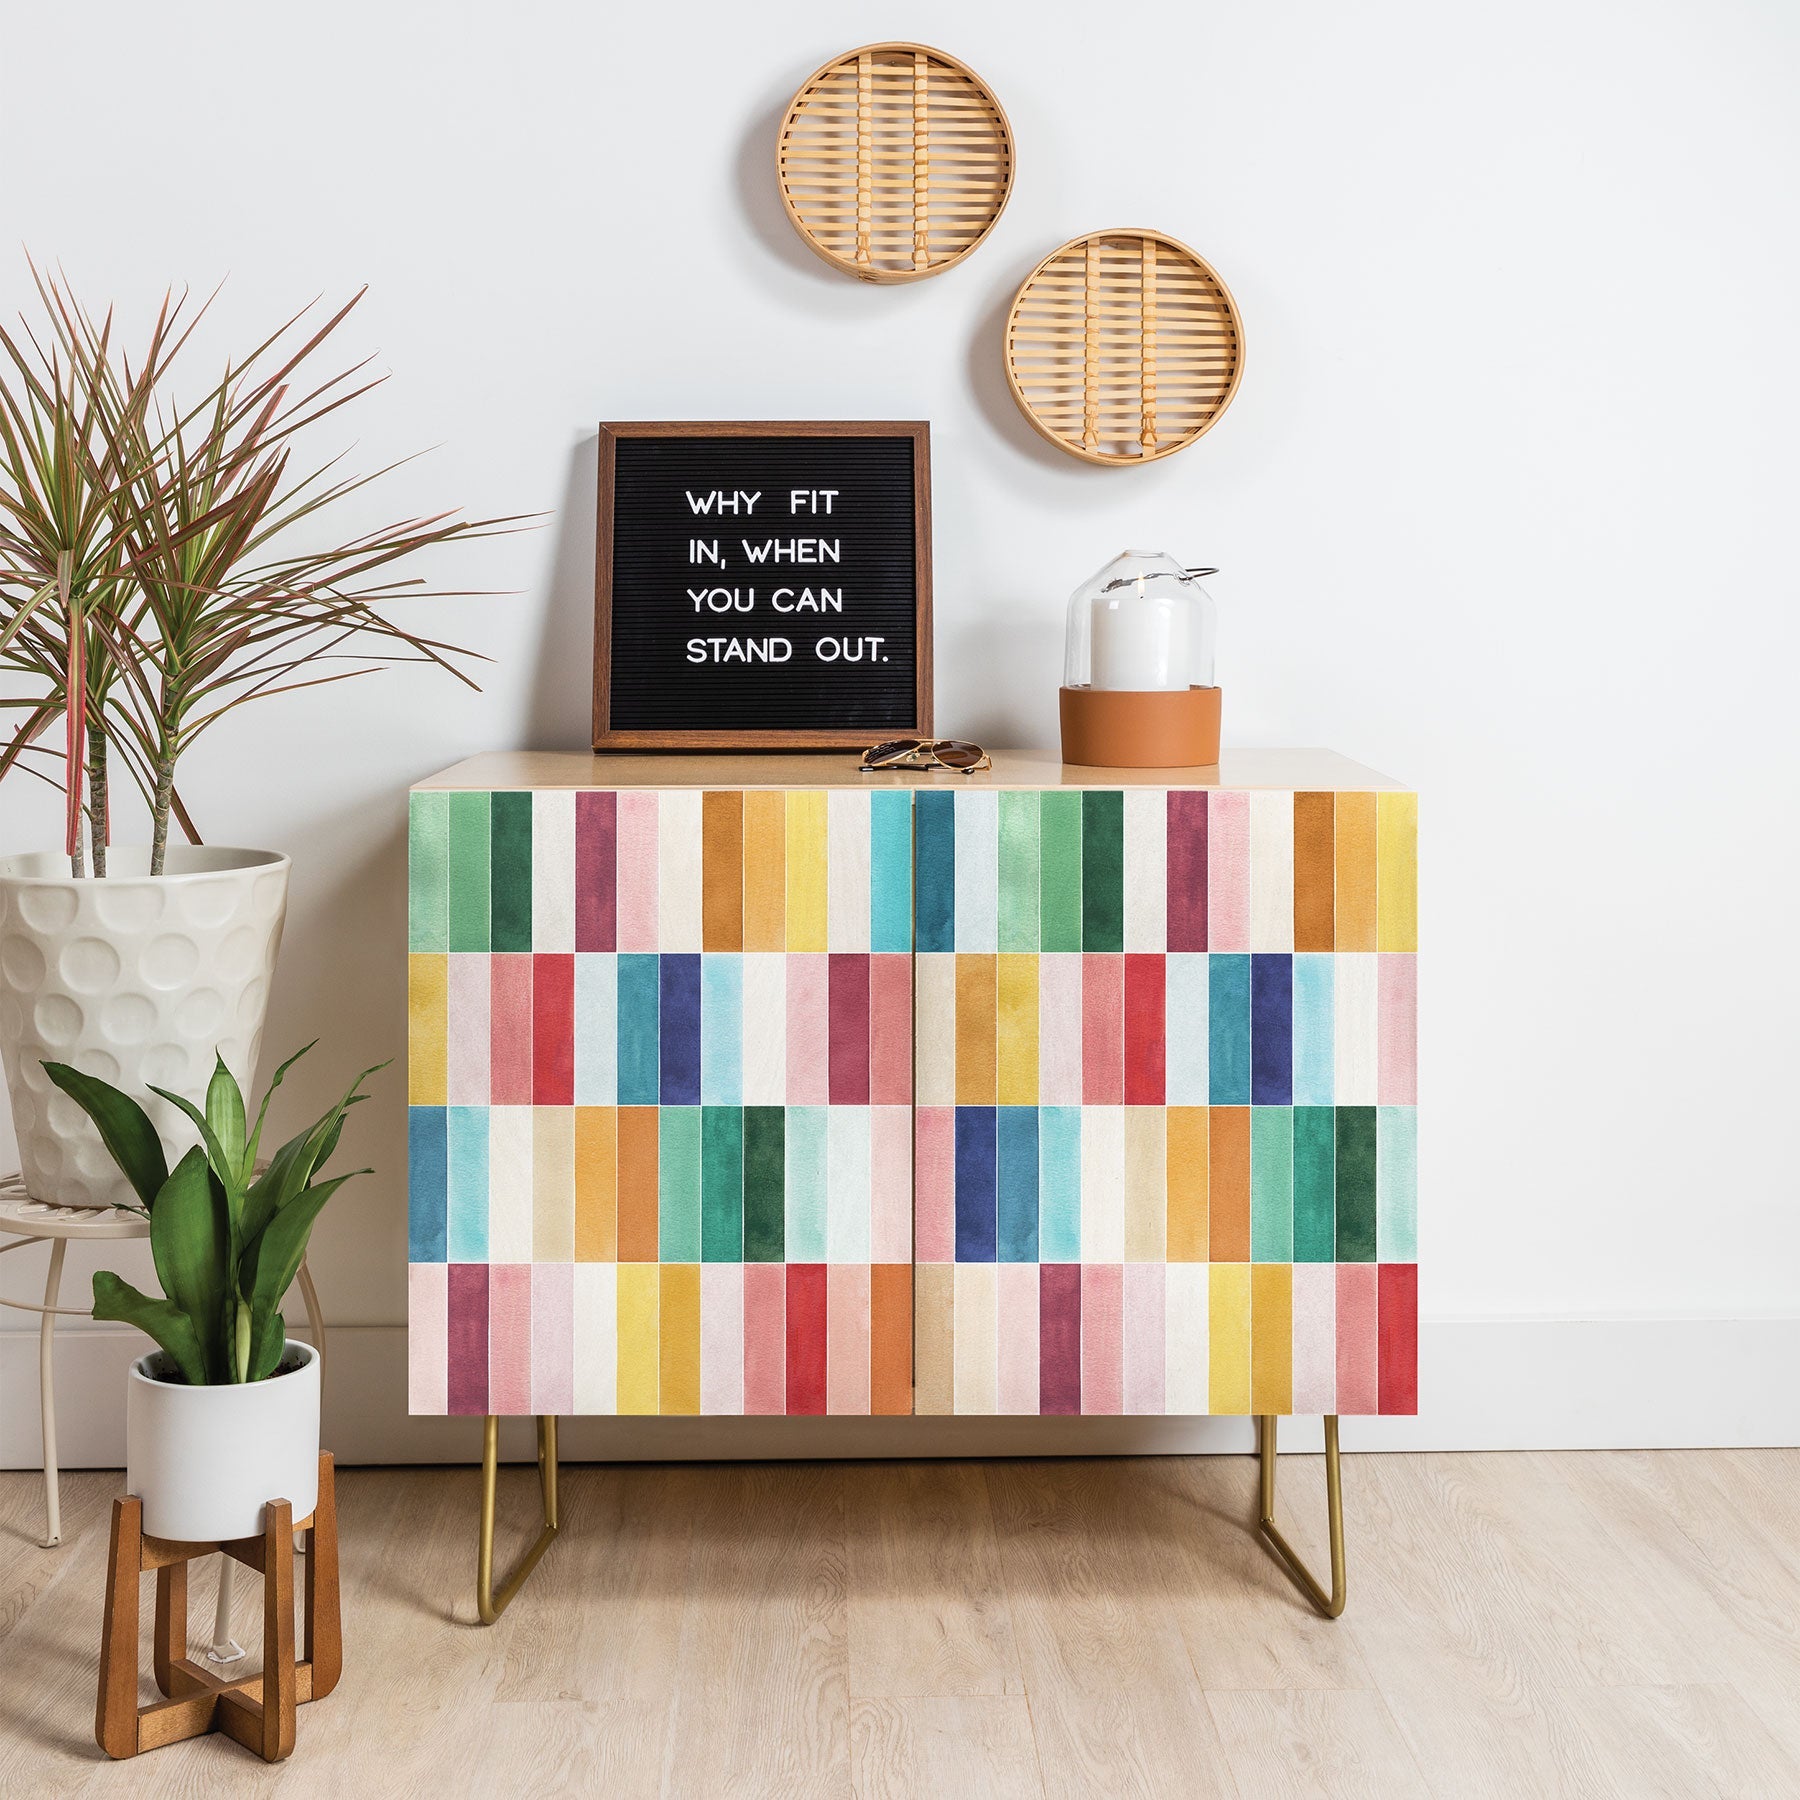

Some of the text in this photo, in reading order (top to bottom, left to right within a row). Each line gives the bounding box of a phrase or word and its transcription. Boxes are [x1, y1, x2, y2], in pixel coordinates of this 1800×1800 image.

[685, 489, 840, 515] WHY FIT
[689, 539, 840, 570] IN, WHEN
[686, 588, 843, 613] YOU CAN
[686, 637, 889, 663] STAND OUT.
